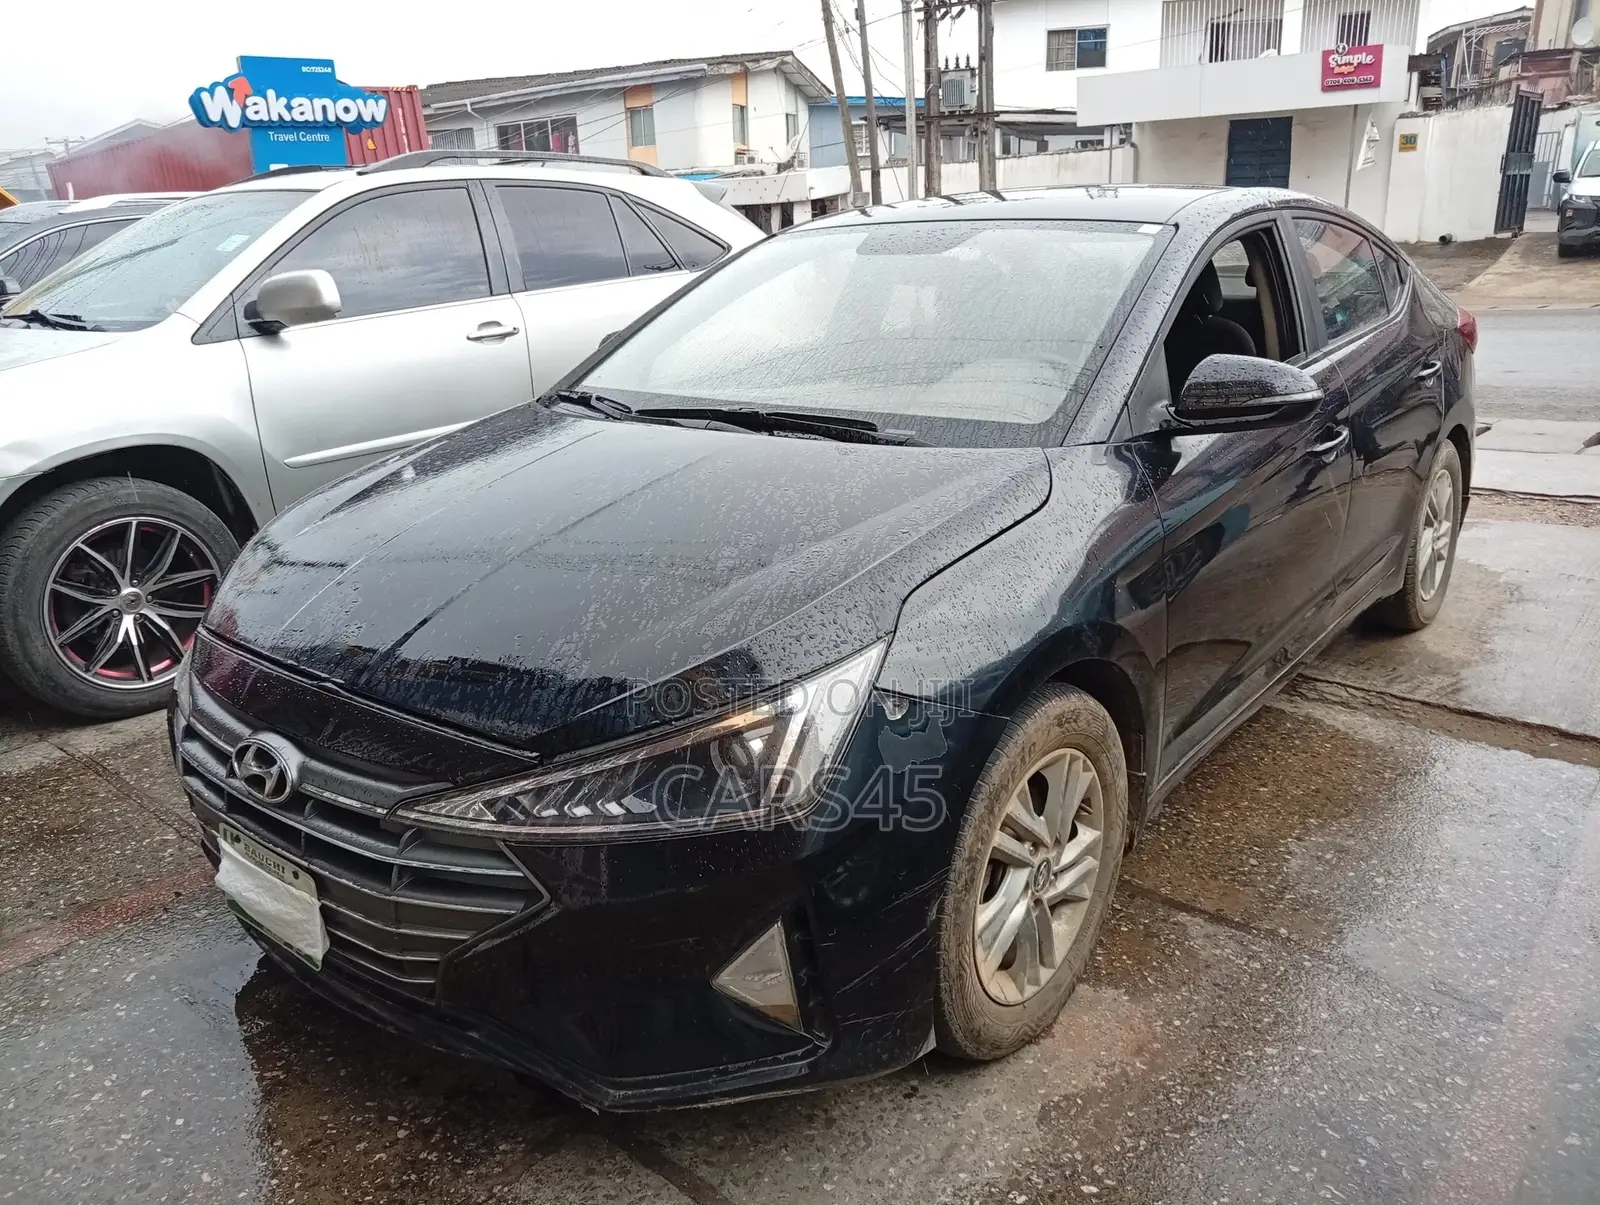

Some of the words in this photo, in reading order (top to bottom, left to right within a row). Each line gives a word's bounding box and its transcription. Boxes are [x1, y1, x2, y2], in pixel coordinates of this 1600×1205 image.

[1328, 52, 1376, 68] Simple
[200, 85, 387, 127] Wakanow
[268, 131, 298, 142] Travel
[299, 132, 330, 143] Centre
[1401, 135, 1416, 145] 30
[243, 843, 286, 875] BAUCHI
